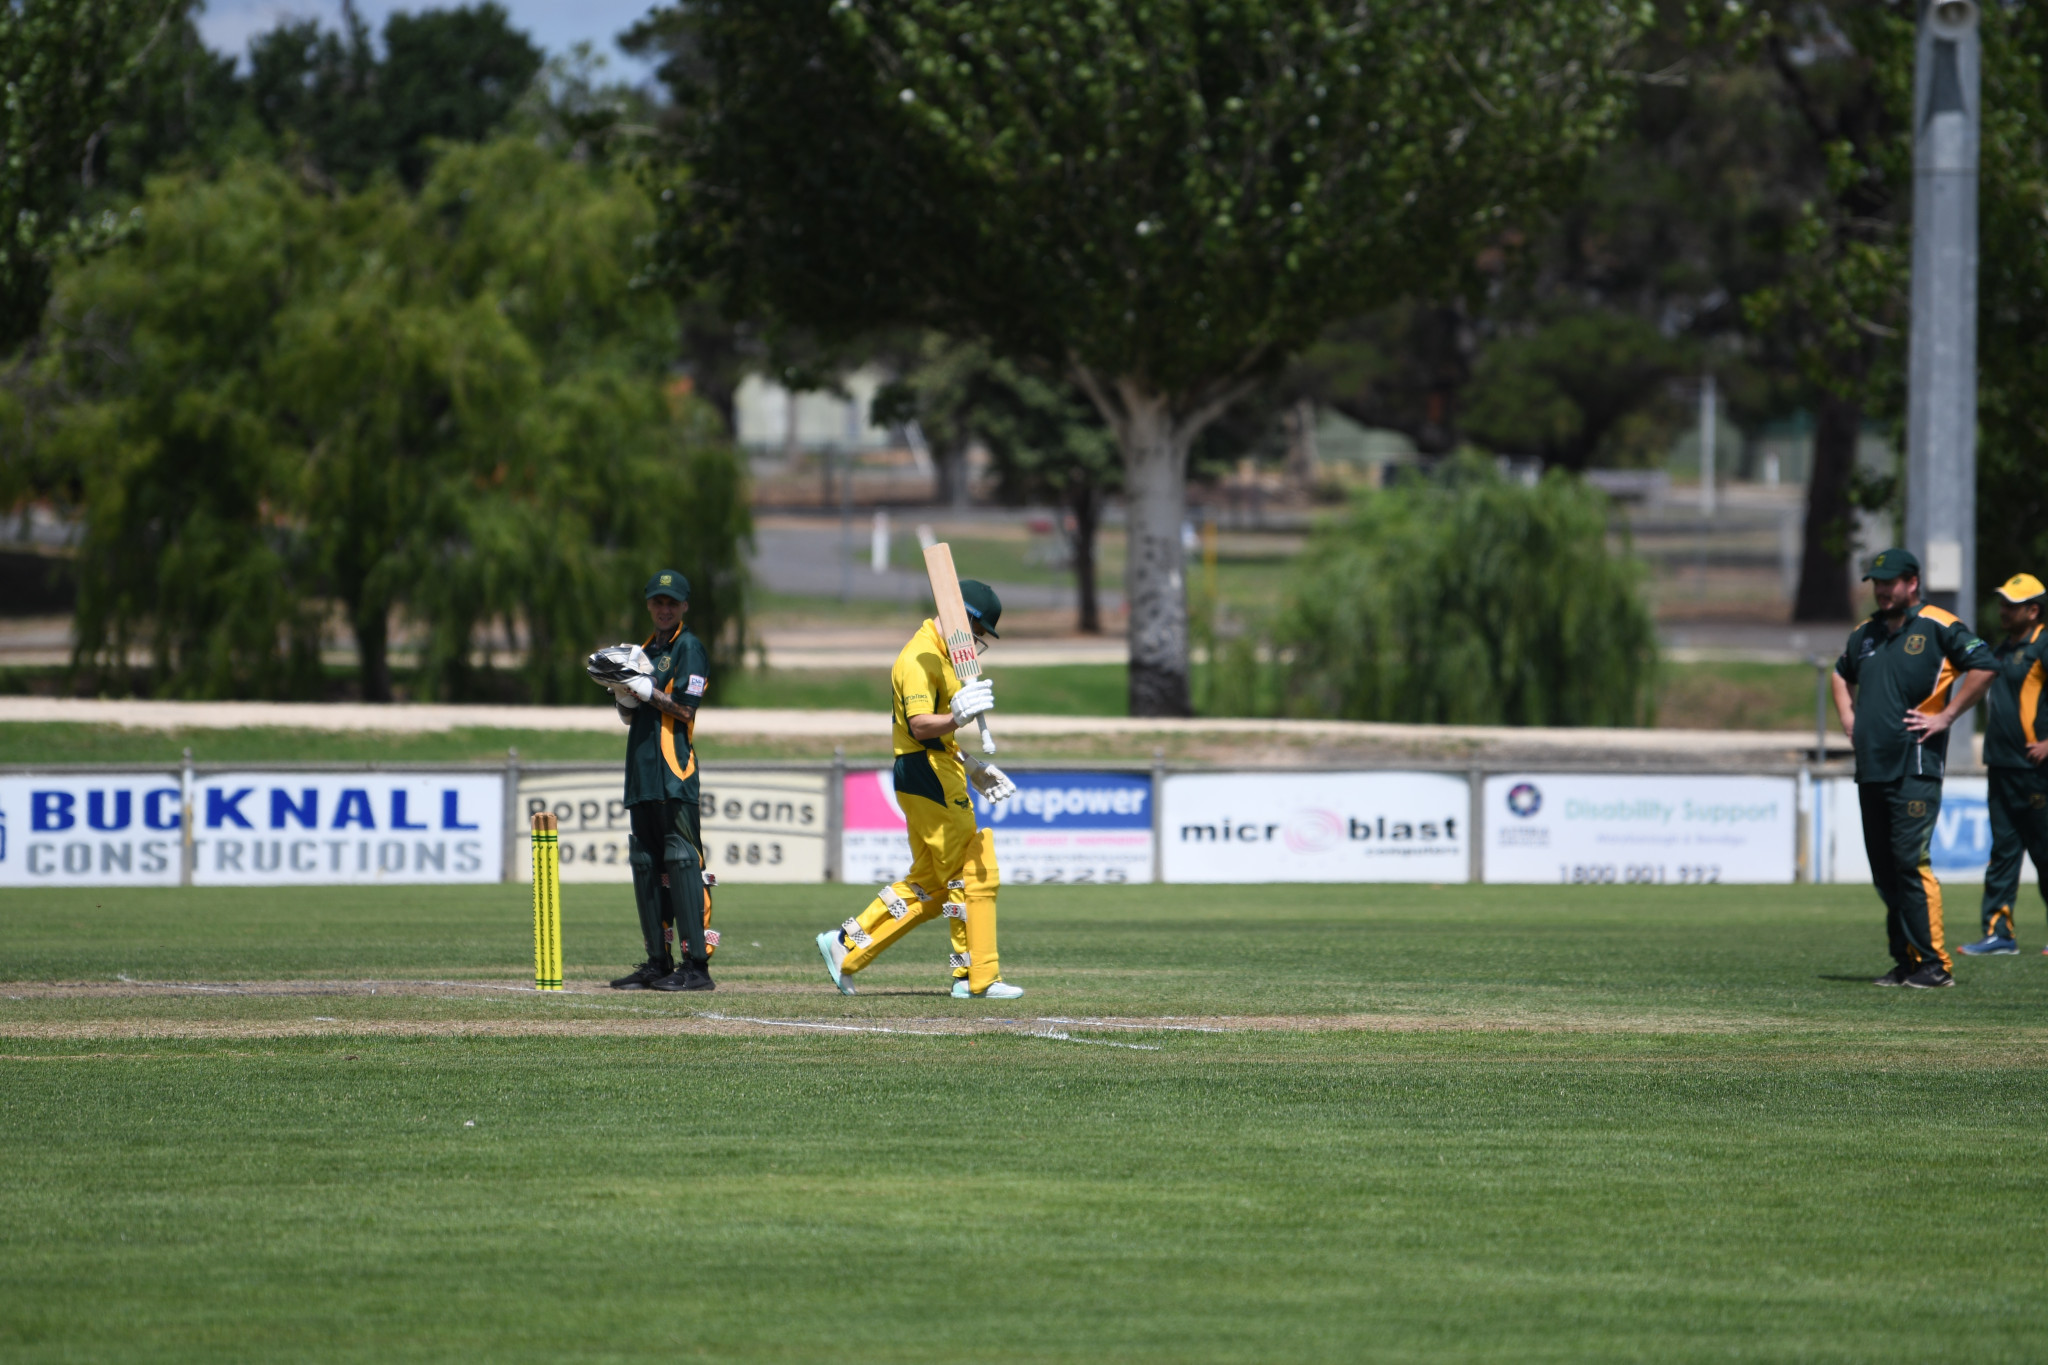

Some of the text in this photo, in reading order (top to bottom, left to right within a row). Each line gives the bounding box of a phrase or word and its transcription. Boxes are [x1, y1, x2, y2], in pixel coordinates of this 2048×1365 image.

[31, 788, 480, 833] BUCKNALL
[699, 792, 816, 826] Beans
[1565, 797, 1779, 824] Disability Support
[1348, 816, 1459, 842] blast
[26, 839, 484, 876] CONSTRUCTIONS
[558, 842, 629, 866] 042
[724, 842, 783, 866] 883
